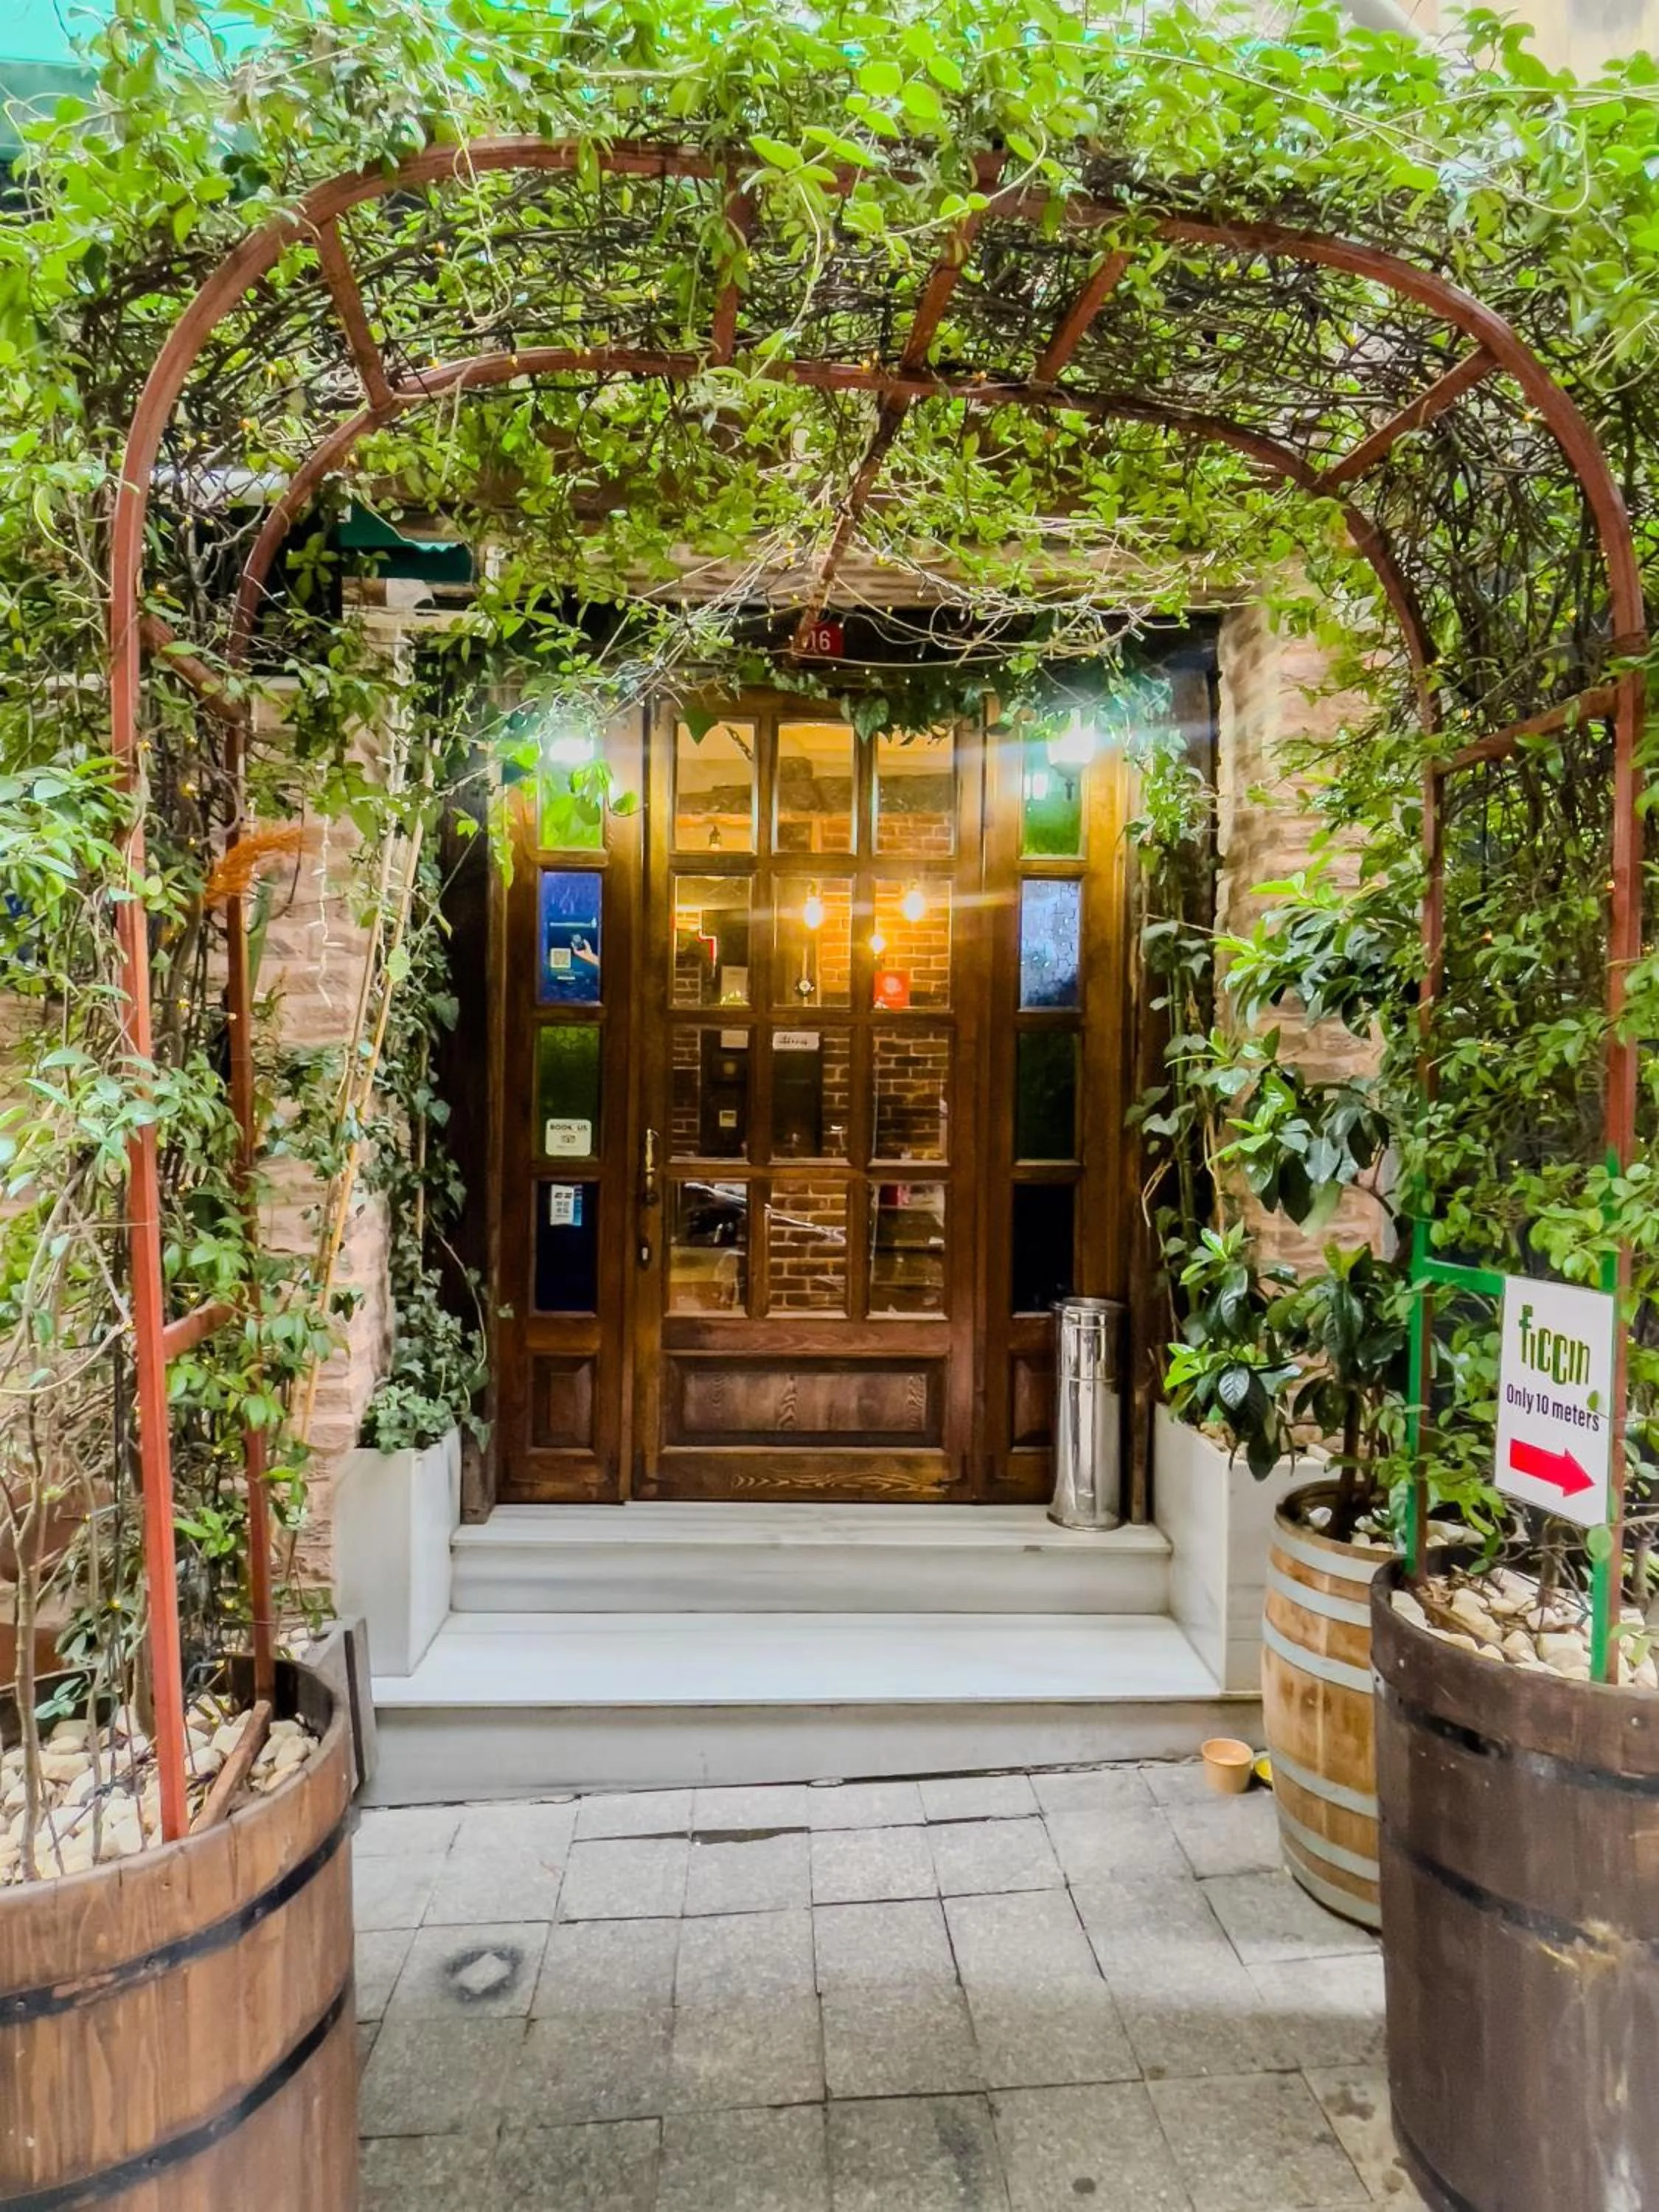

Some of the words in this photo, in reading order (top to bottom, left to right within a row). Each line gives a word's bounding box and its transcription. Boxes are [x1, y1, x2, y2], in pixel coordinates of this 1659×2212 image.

[810, 630, 831, 651] 16
[1506, 1383, 1534, 1415] Only
[1537, 1393, 1549, 1415] 10
[1552, 1401, 1599, 1432] meters
